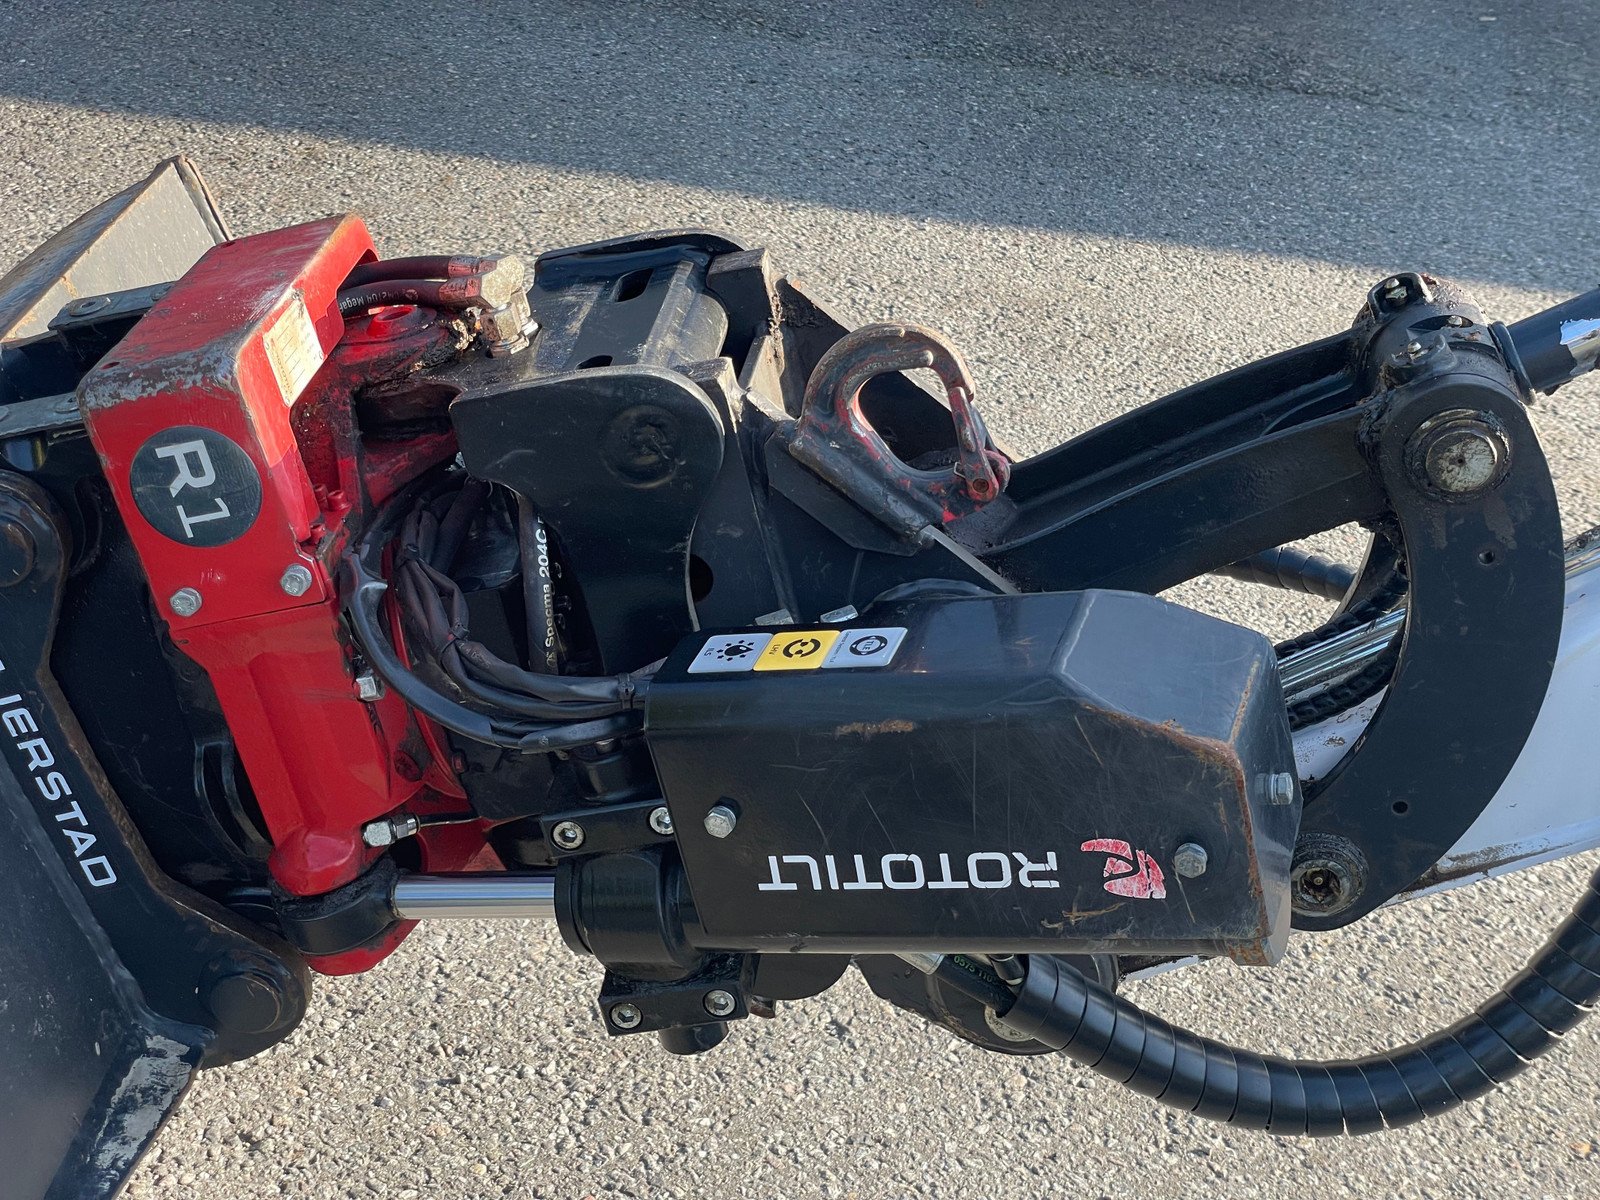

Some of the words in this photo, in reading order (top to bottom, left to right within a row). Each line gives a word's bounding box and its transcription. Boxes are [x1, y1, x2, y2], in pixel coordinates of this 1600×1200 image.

[154, 439, 231, 538] R1
[535, 528, 551, 578] 204C
[543, 584, 555, 648] Specma
[0, 660, 118, 887] ERSTAD
[757, 851, 1060, 891] ROTOTILT
